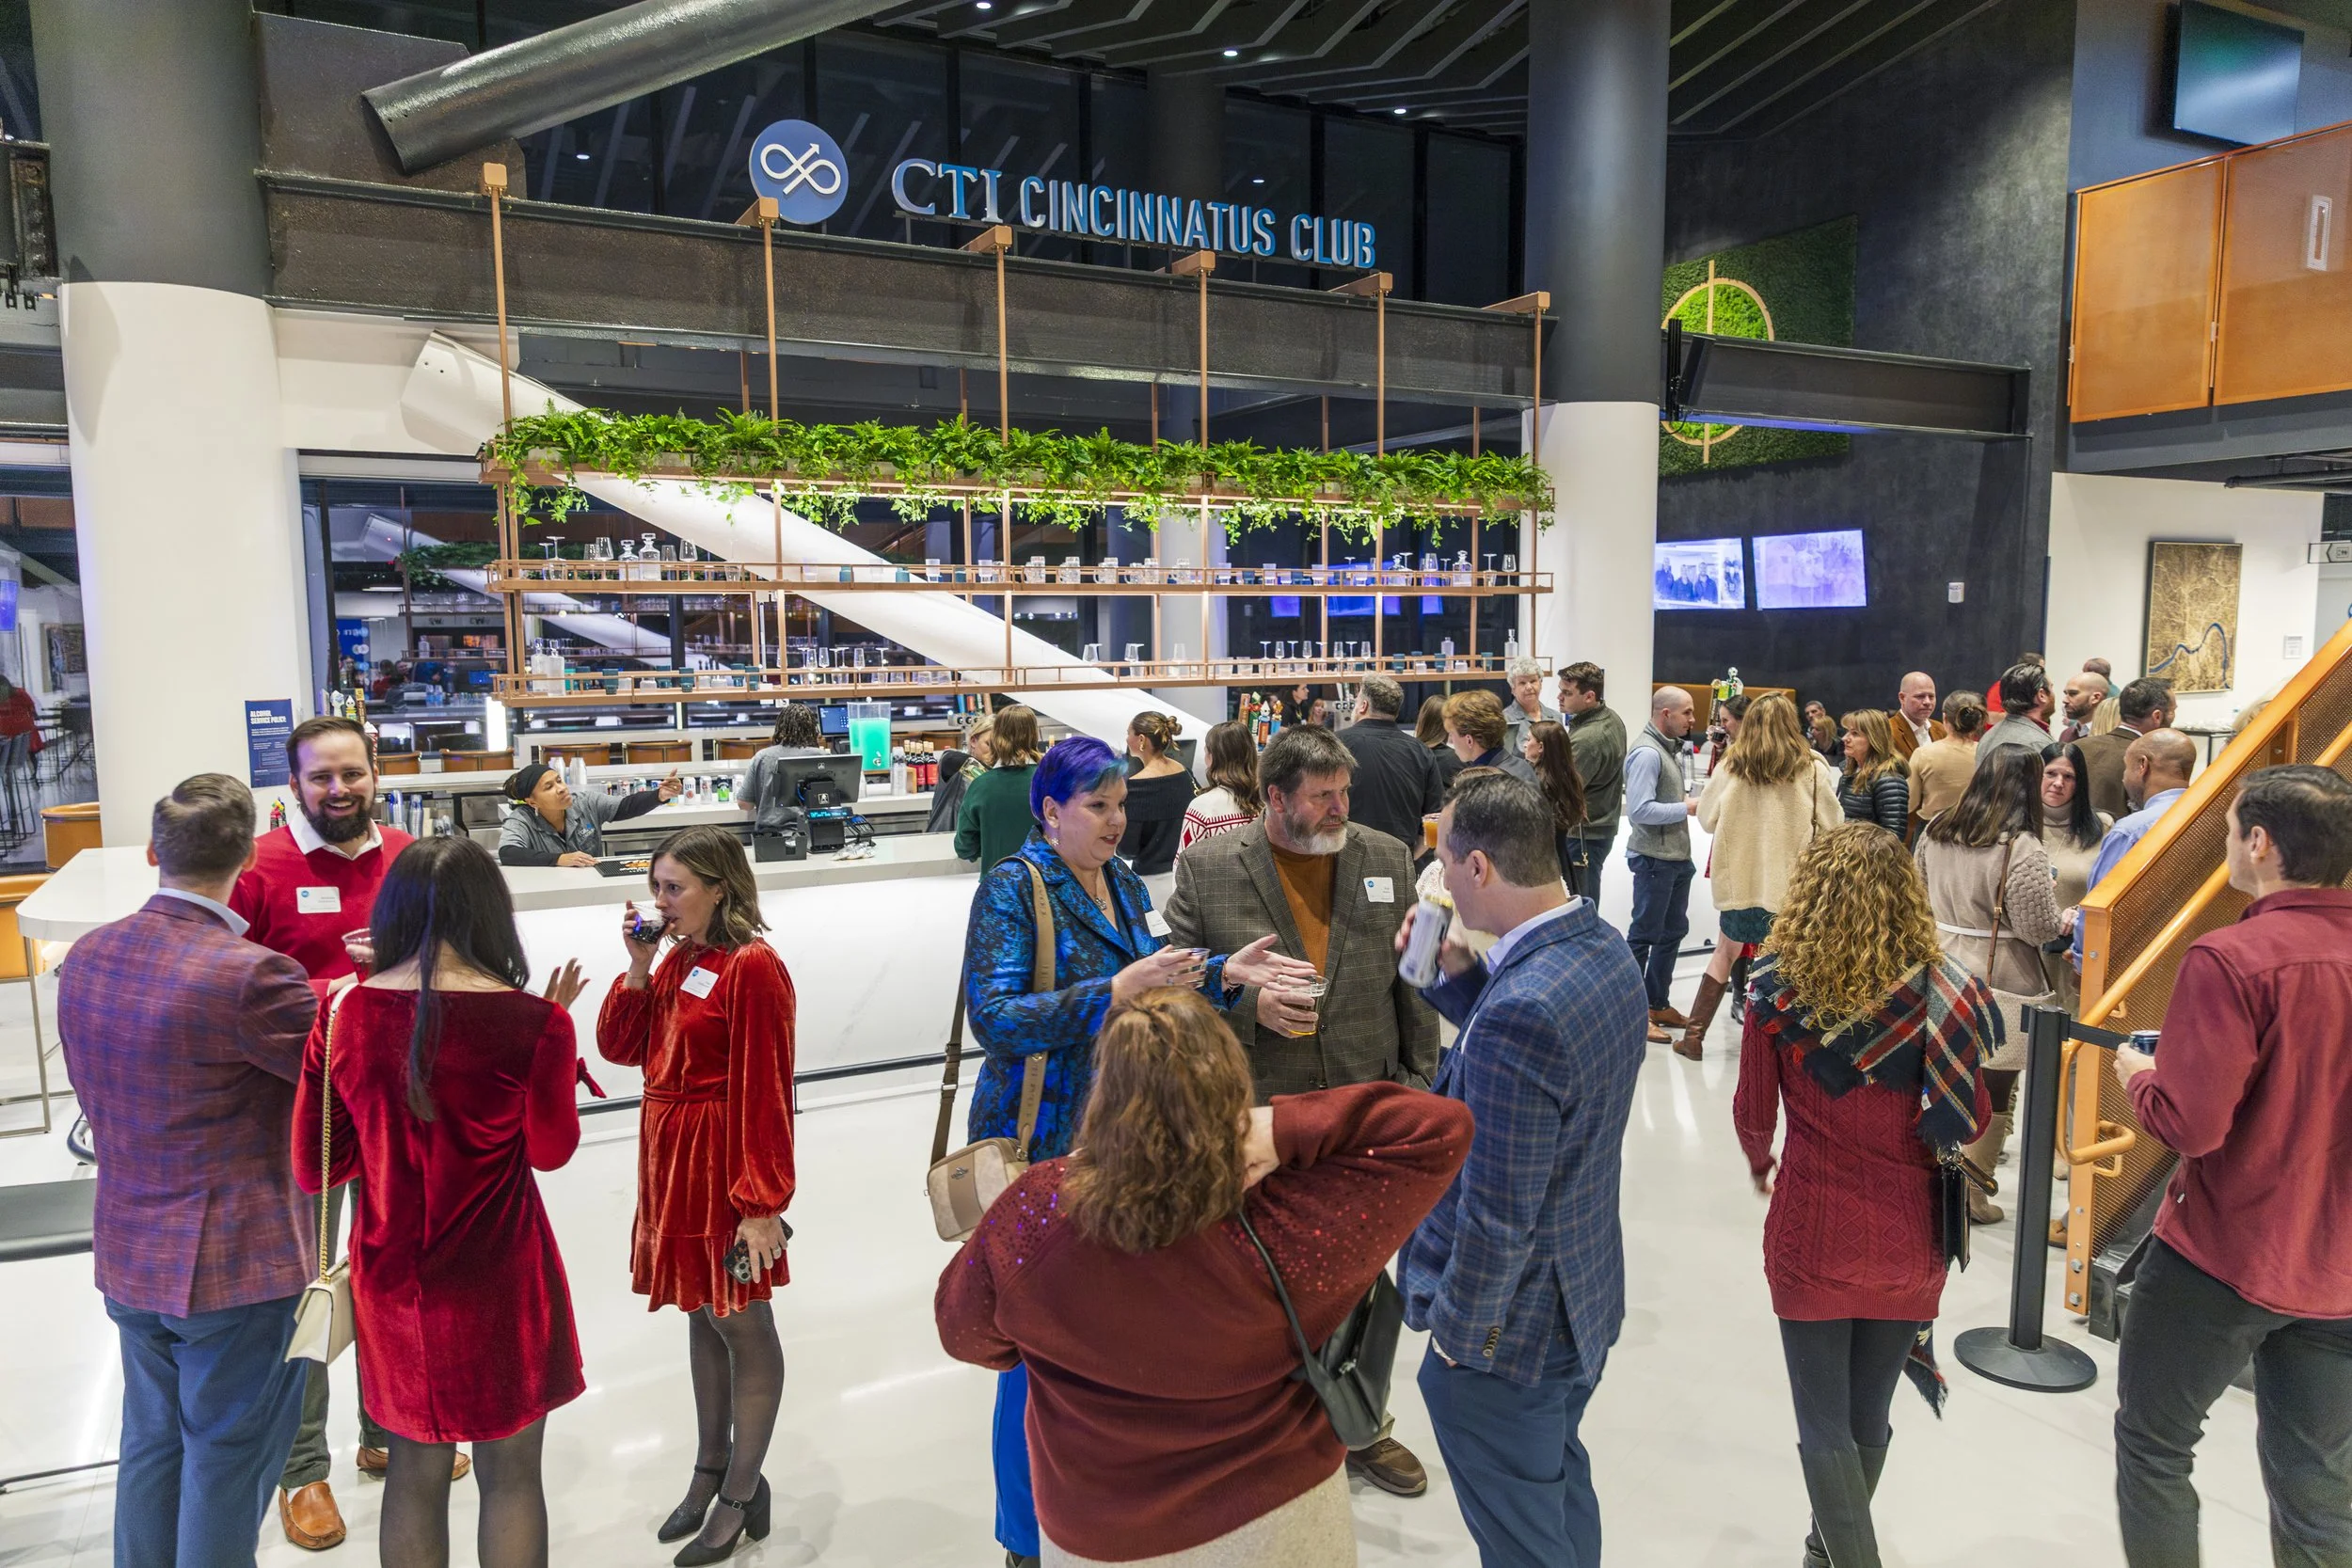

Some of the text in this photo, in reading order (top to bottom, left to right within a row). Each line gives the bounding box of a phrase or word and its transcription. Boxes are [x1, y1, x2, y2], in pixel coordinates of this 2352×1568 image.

[892, 158, 1376, 269] CTI CINCINNATUS CLUB
